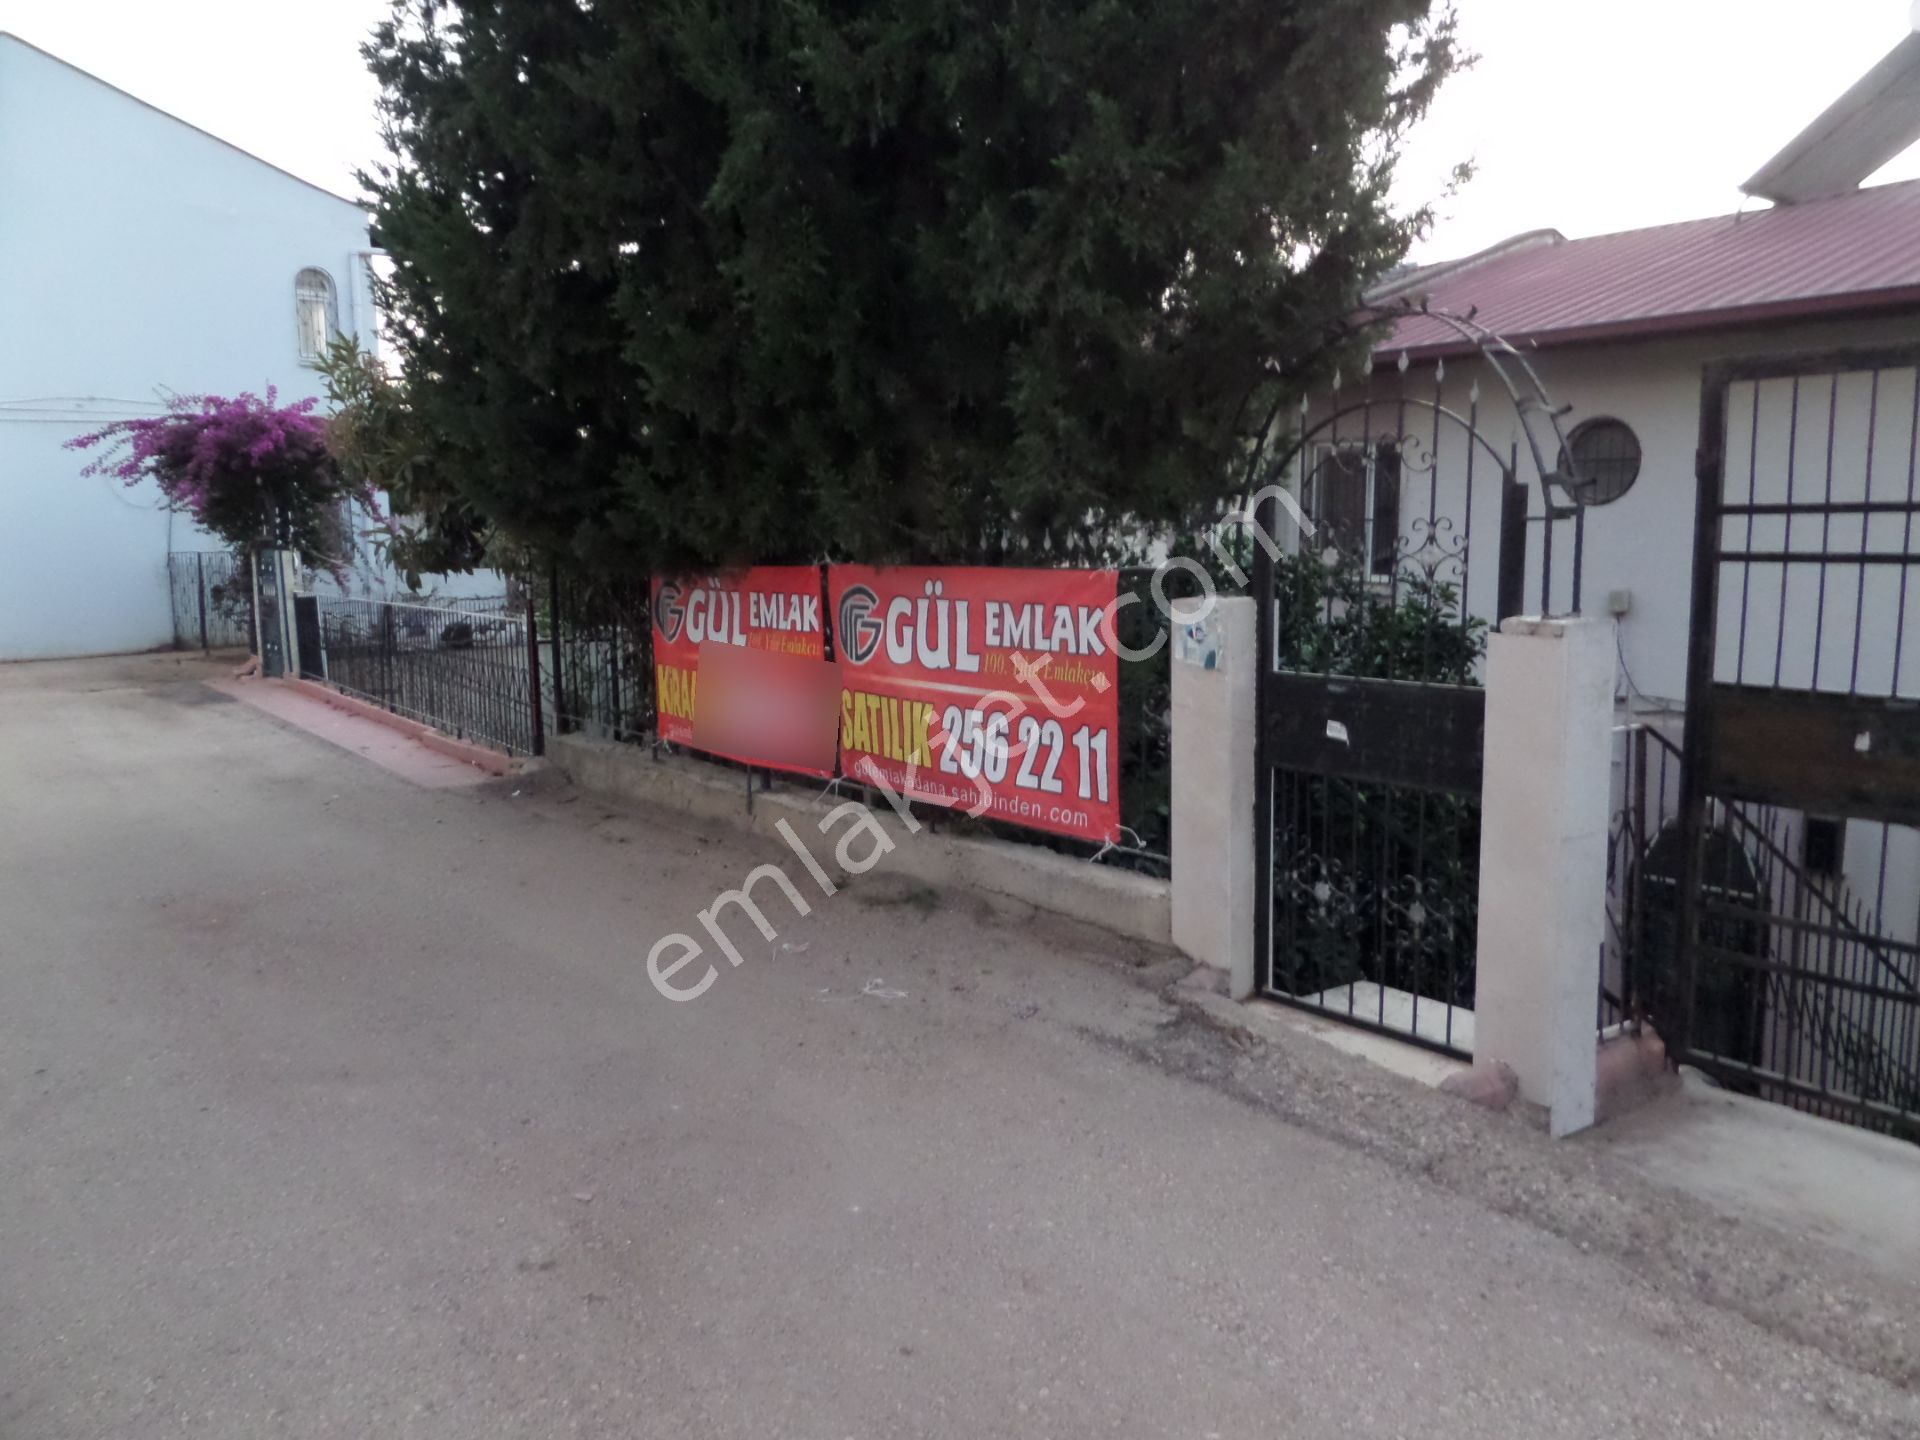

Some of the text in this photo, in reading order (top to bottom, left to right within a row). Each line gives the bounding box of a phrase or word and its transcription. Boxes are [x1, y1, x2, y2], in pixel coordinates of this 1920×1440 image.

[686, 577, 747, 647] GÜL
[749, 591, 820, 633] EMLAK
[886, 579, 980, 673] GÜL
[985, 601, 1106, 656] EMLAK
[842, 688, 1108, 802] SATILIK 256 22 11
